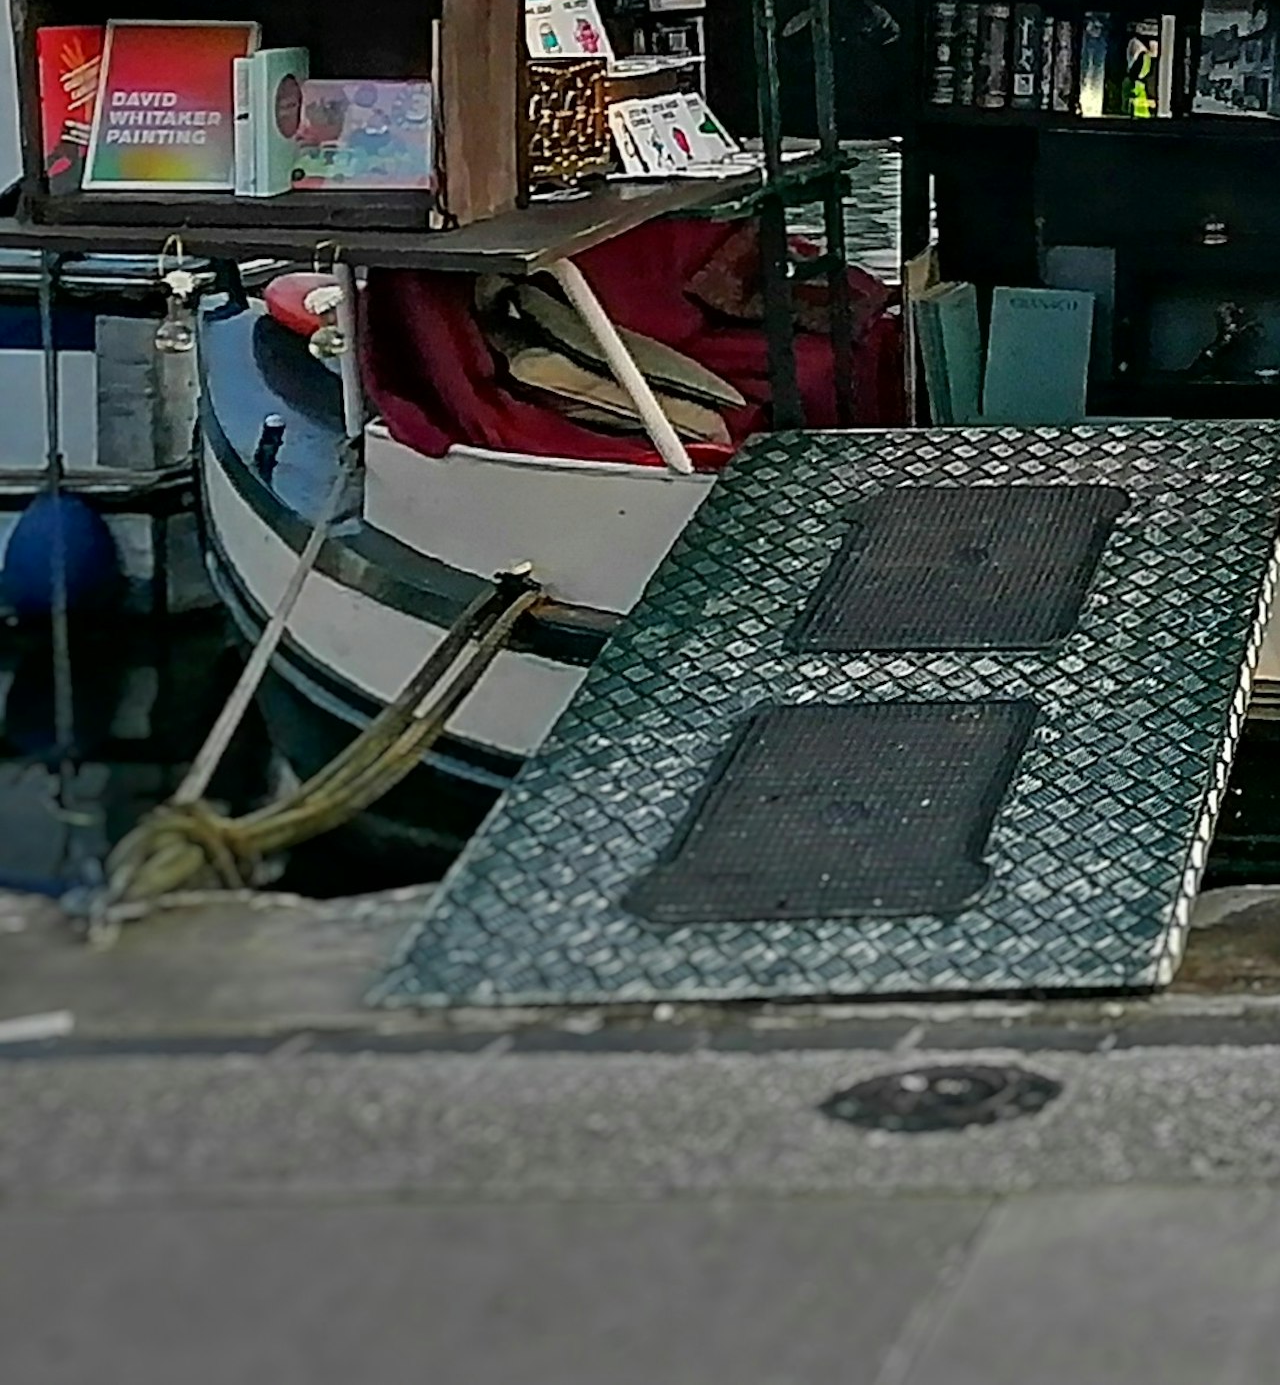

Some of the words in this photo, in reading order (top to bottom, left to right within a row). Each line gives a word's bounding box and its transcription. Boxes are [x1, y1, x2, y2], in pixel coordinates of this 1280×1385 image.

[111, 91, 178, 107] DAVID
[109, 110, 222, 126] WHITAKER
[105, 129, 207, 145] PAINTING
